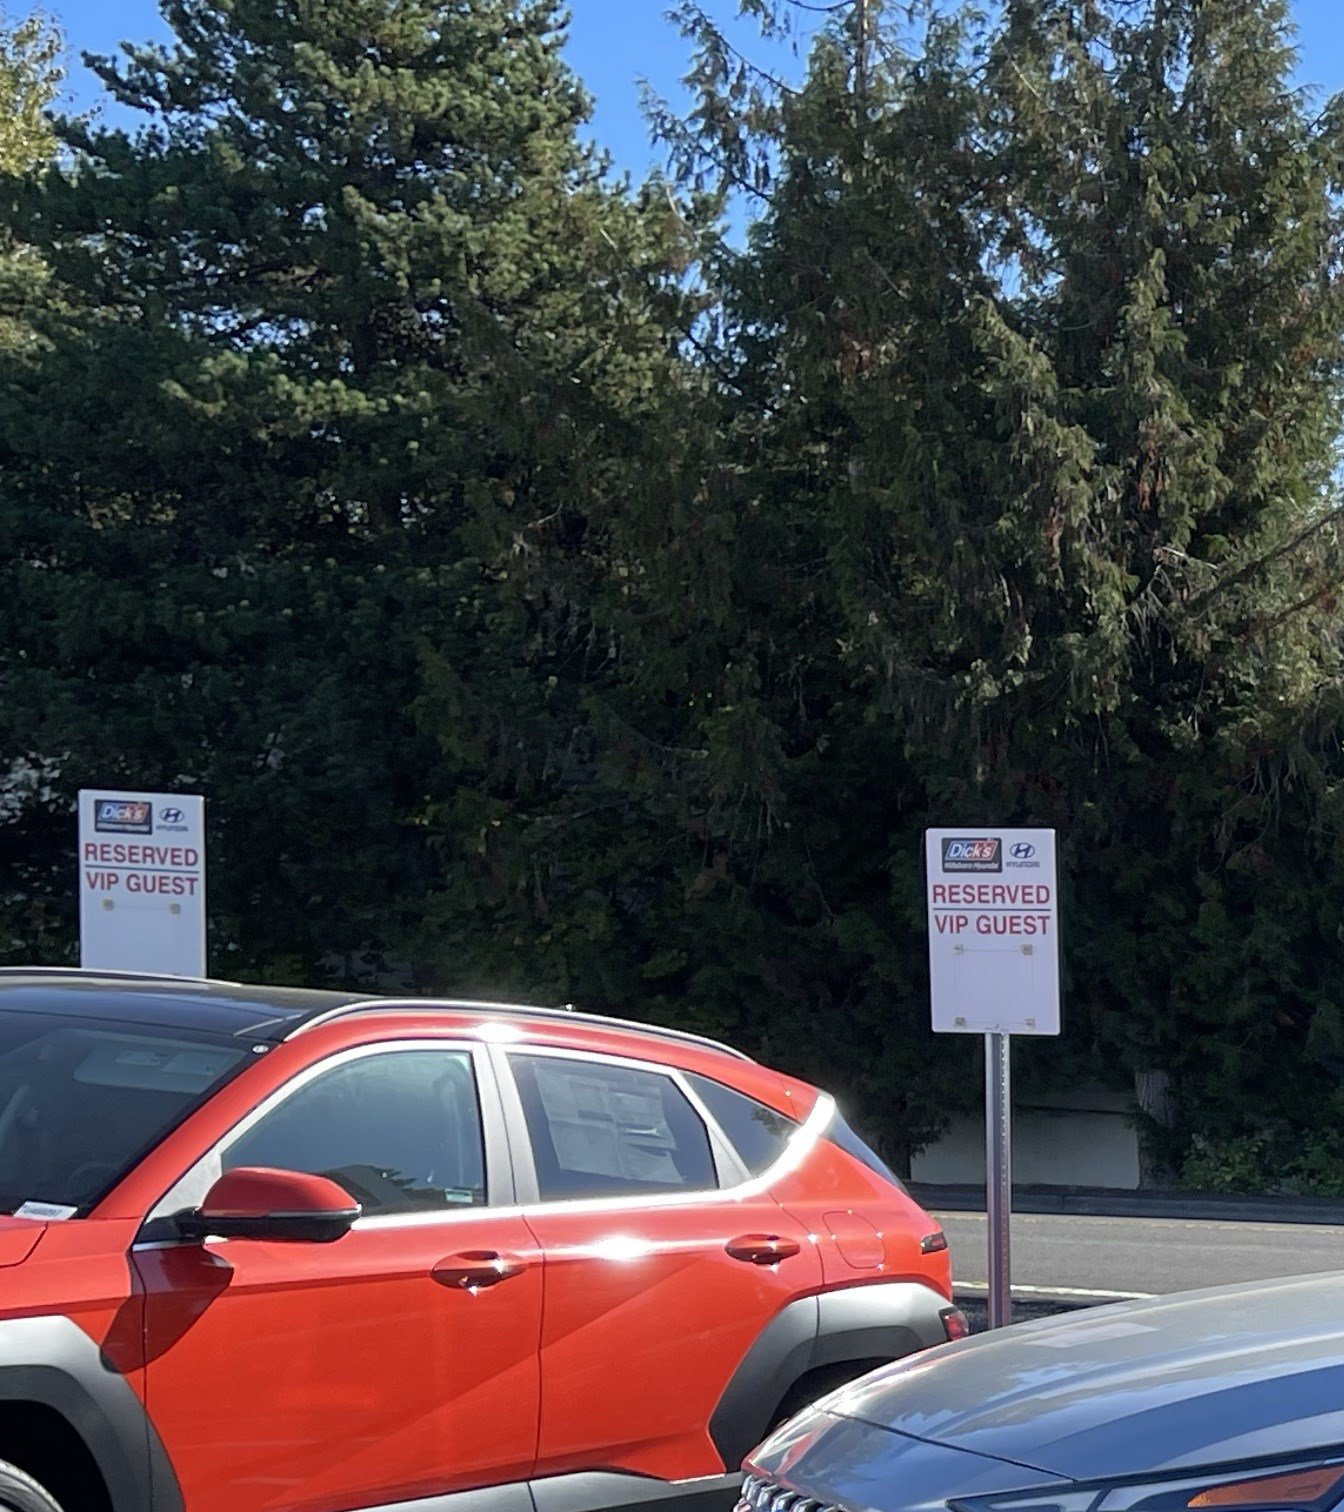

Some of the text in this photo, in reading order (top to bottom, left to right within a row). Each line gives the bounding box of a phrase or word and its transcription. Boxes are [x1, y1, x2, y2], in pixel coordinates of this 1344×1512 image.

[84, 842, 199, 867] RESERVED
[86, 871, 199, 896] VIP GUEST
[932, 884, 1050, 905] RESERVED
[934, 914, 1051, 936] VIP GUEST
